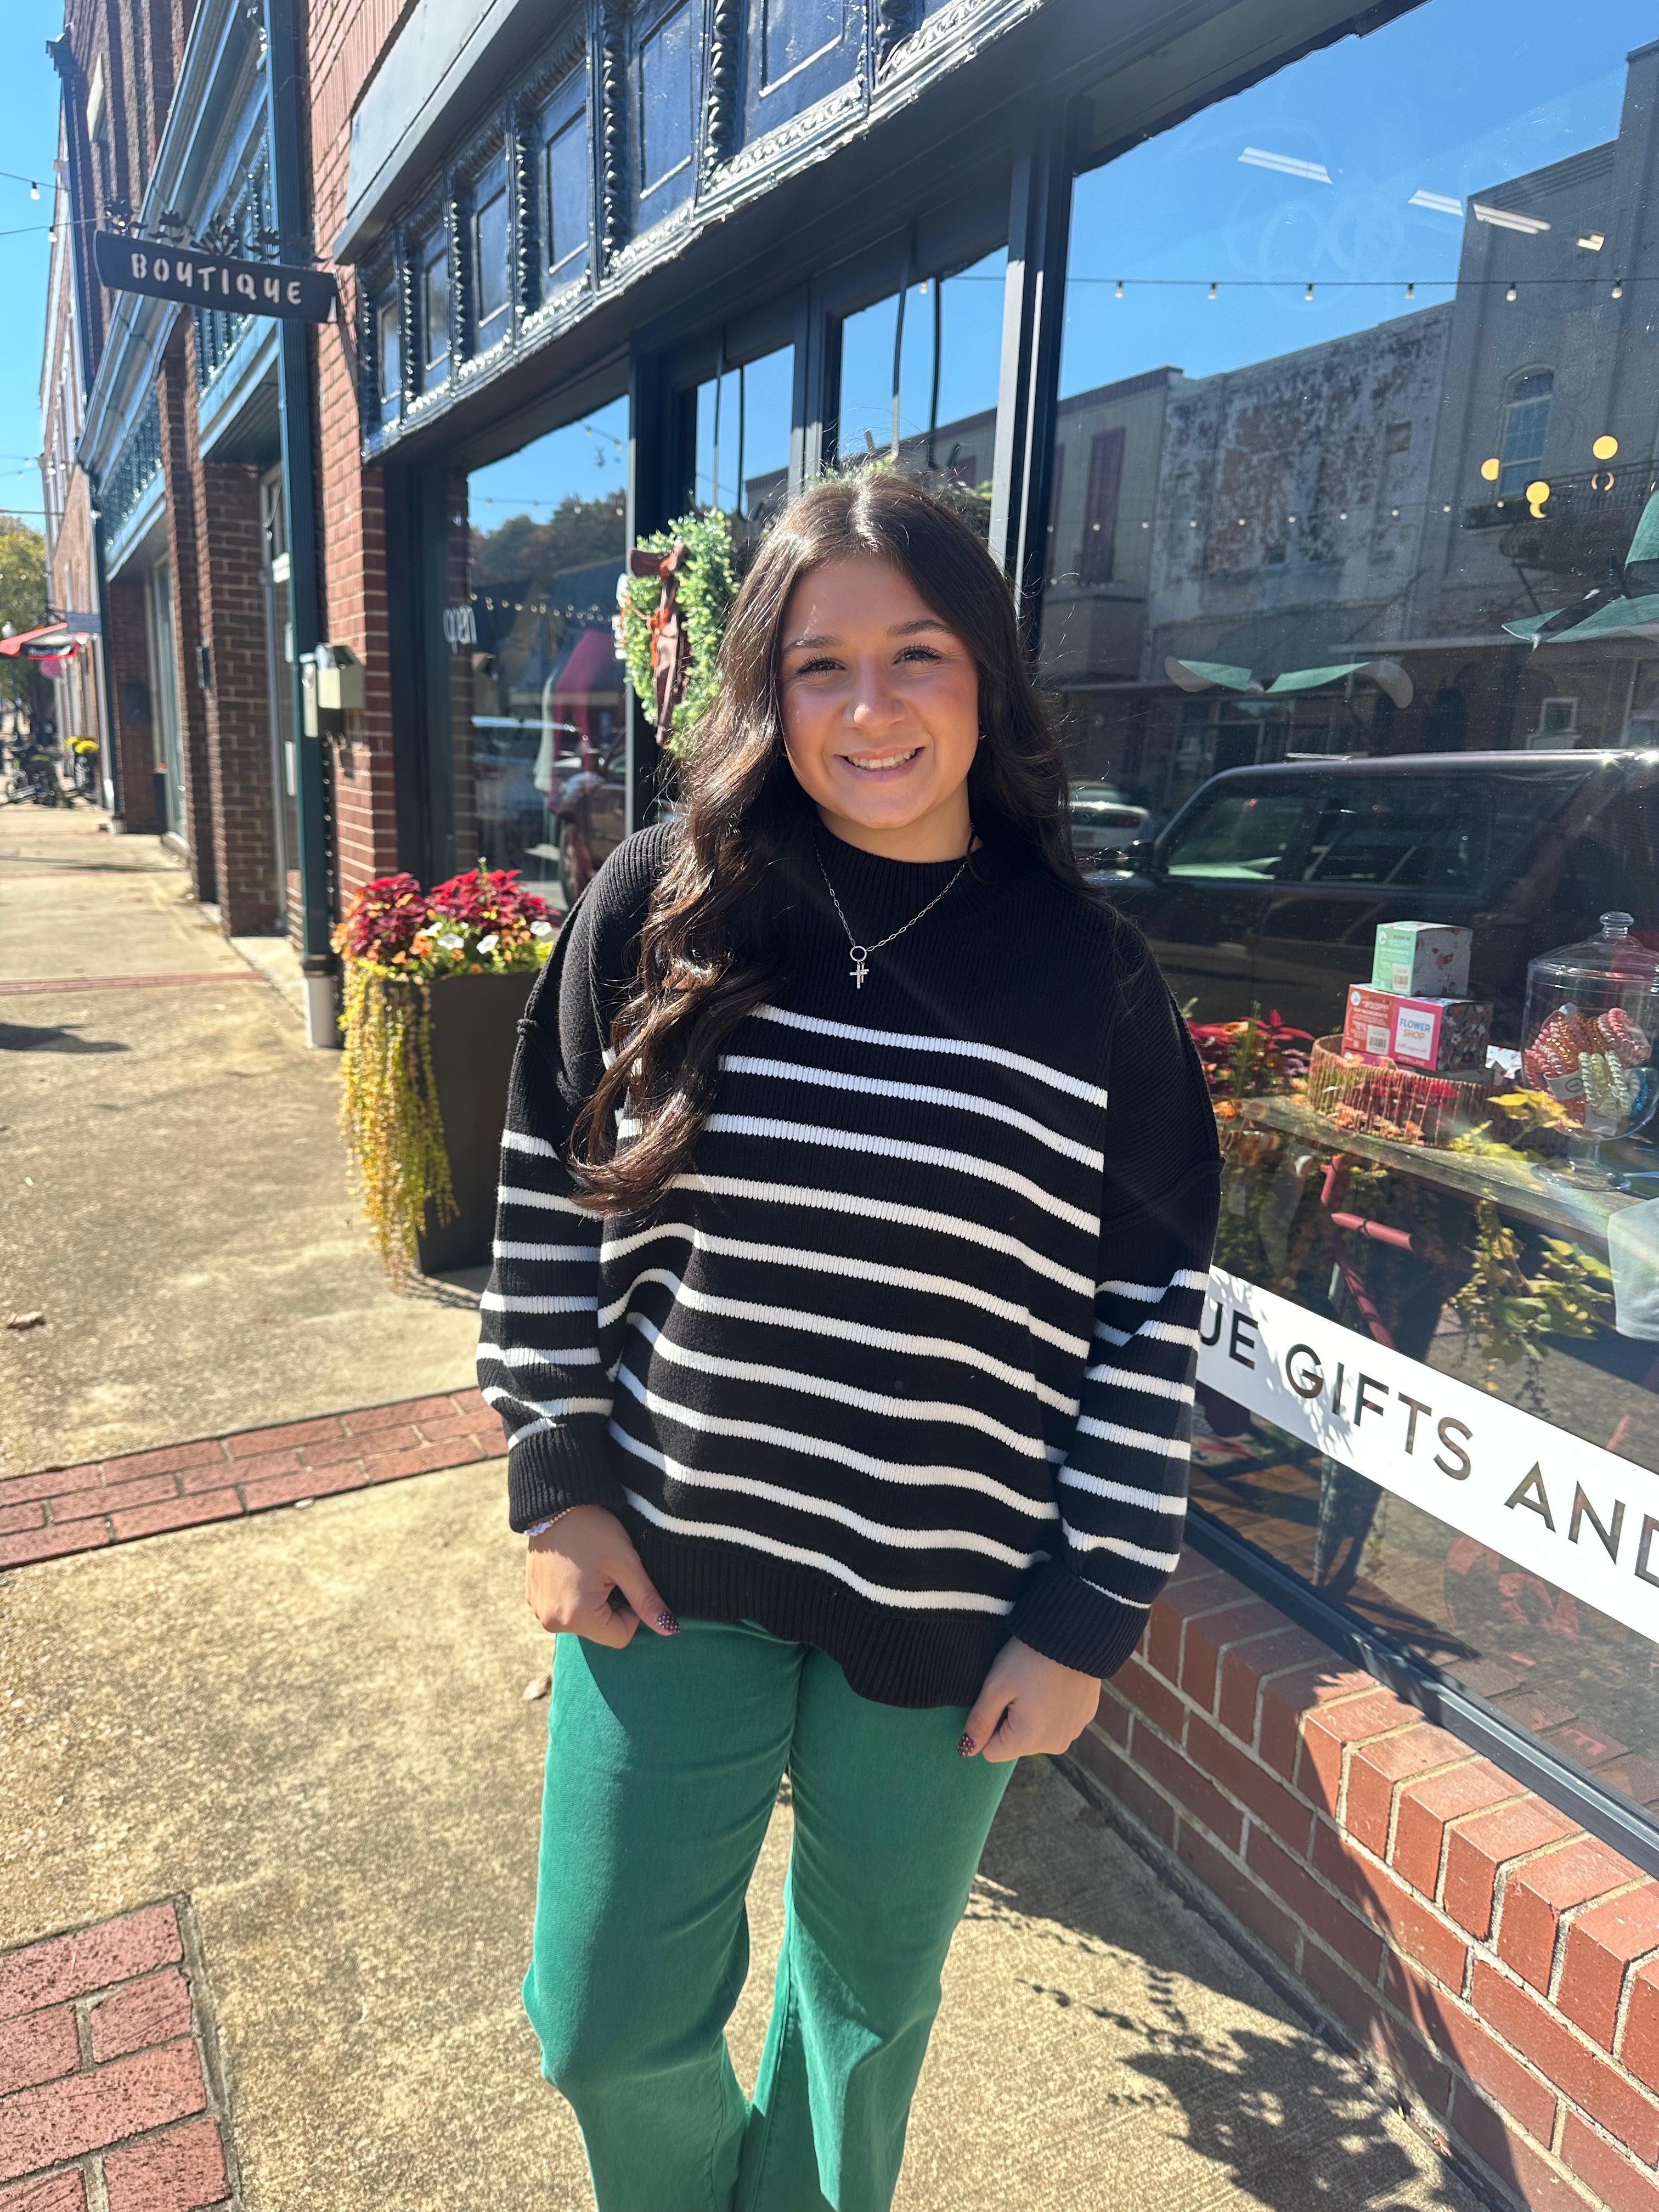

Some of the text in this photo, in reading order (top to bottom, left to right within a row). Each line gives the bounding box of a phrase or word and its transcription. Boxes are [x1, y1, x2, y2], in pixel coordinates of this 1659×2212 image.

[131, 253, 302, 305] BOUTIQUE
[1400, 1018, 1431, 1032] FLOWER
[1403, 1028, 1425, 1040] SHOP
[1285, 1343, 1473, 1481] GIFTS
